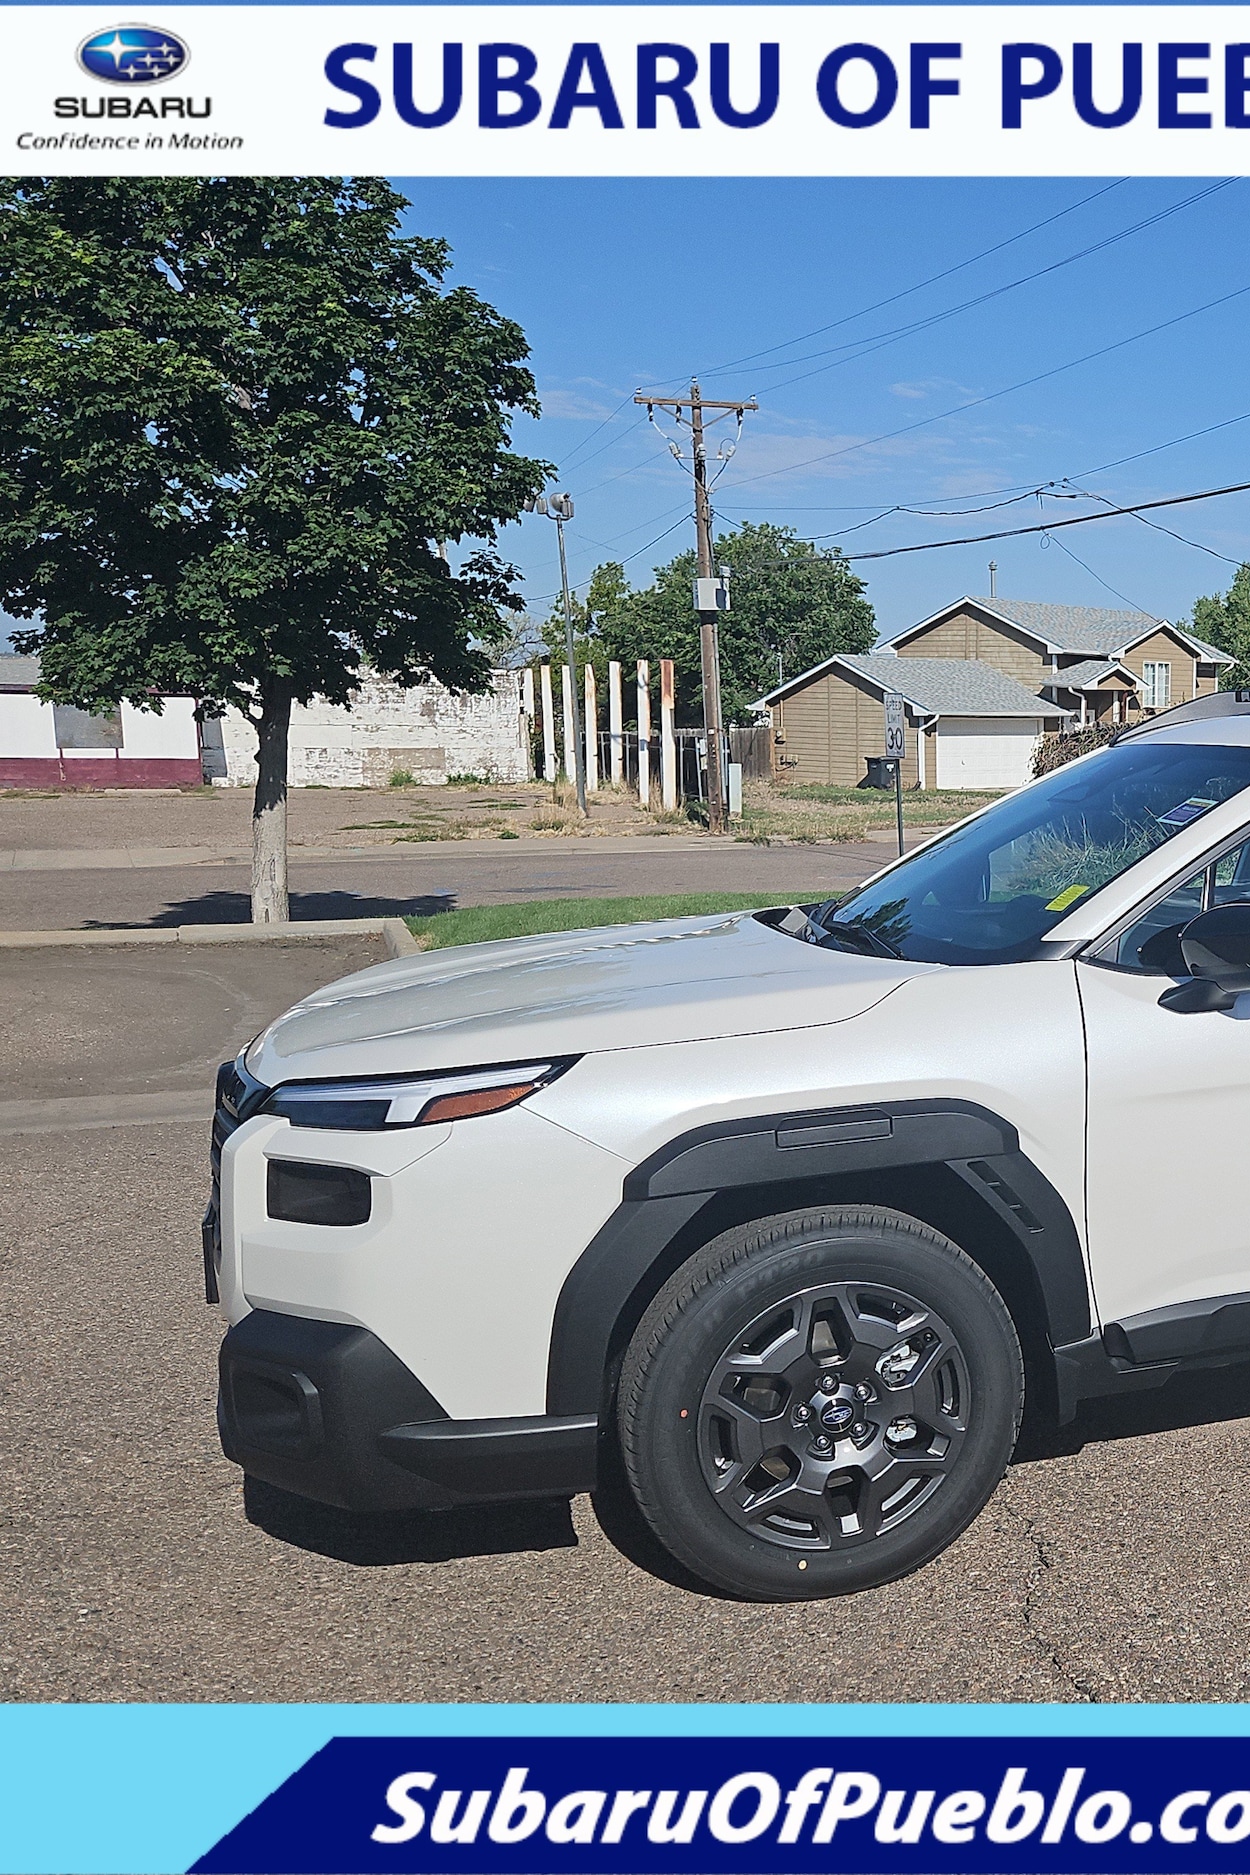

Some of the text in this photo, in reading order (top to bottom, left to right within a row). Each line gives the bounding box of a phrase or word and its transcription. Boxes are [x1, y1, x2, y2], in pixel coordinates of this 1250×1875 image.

[886, 700, 902, 711] SPEED
[887, 714, 900, 724] LIMIT
[887, 727, 903, 750] 30
